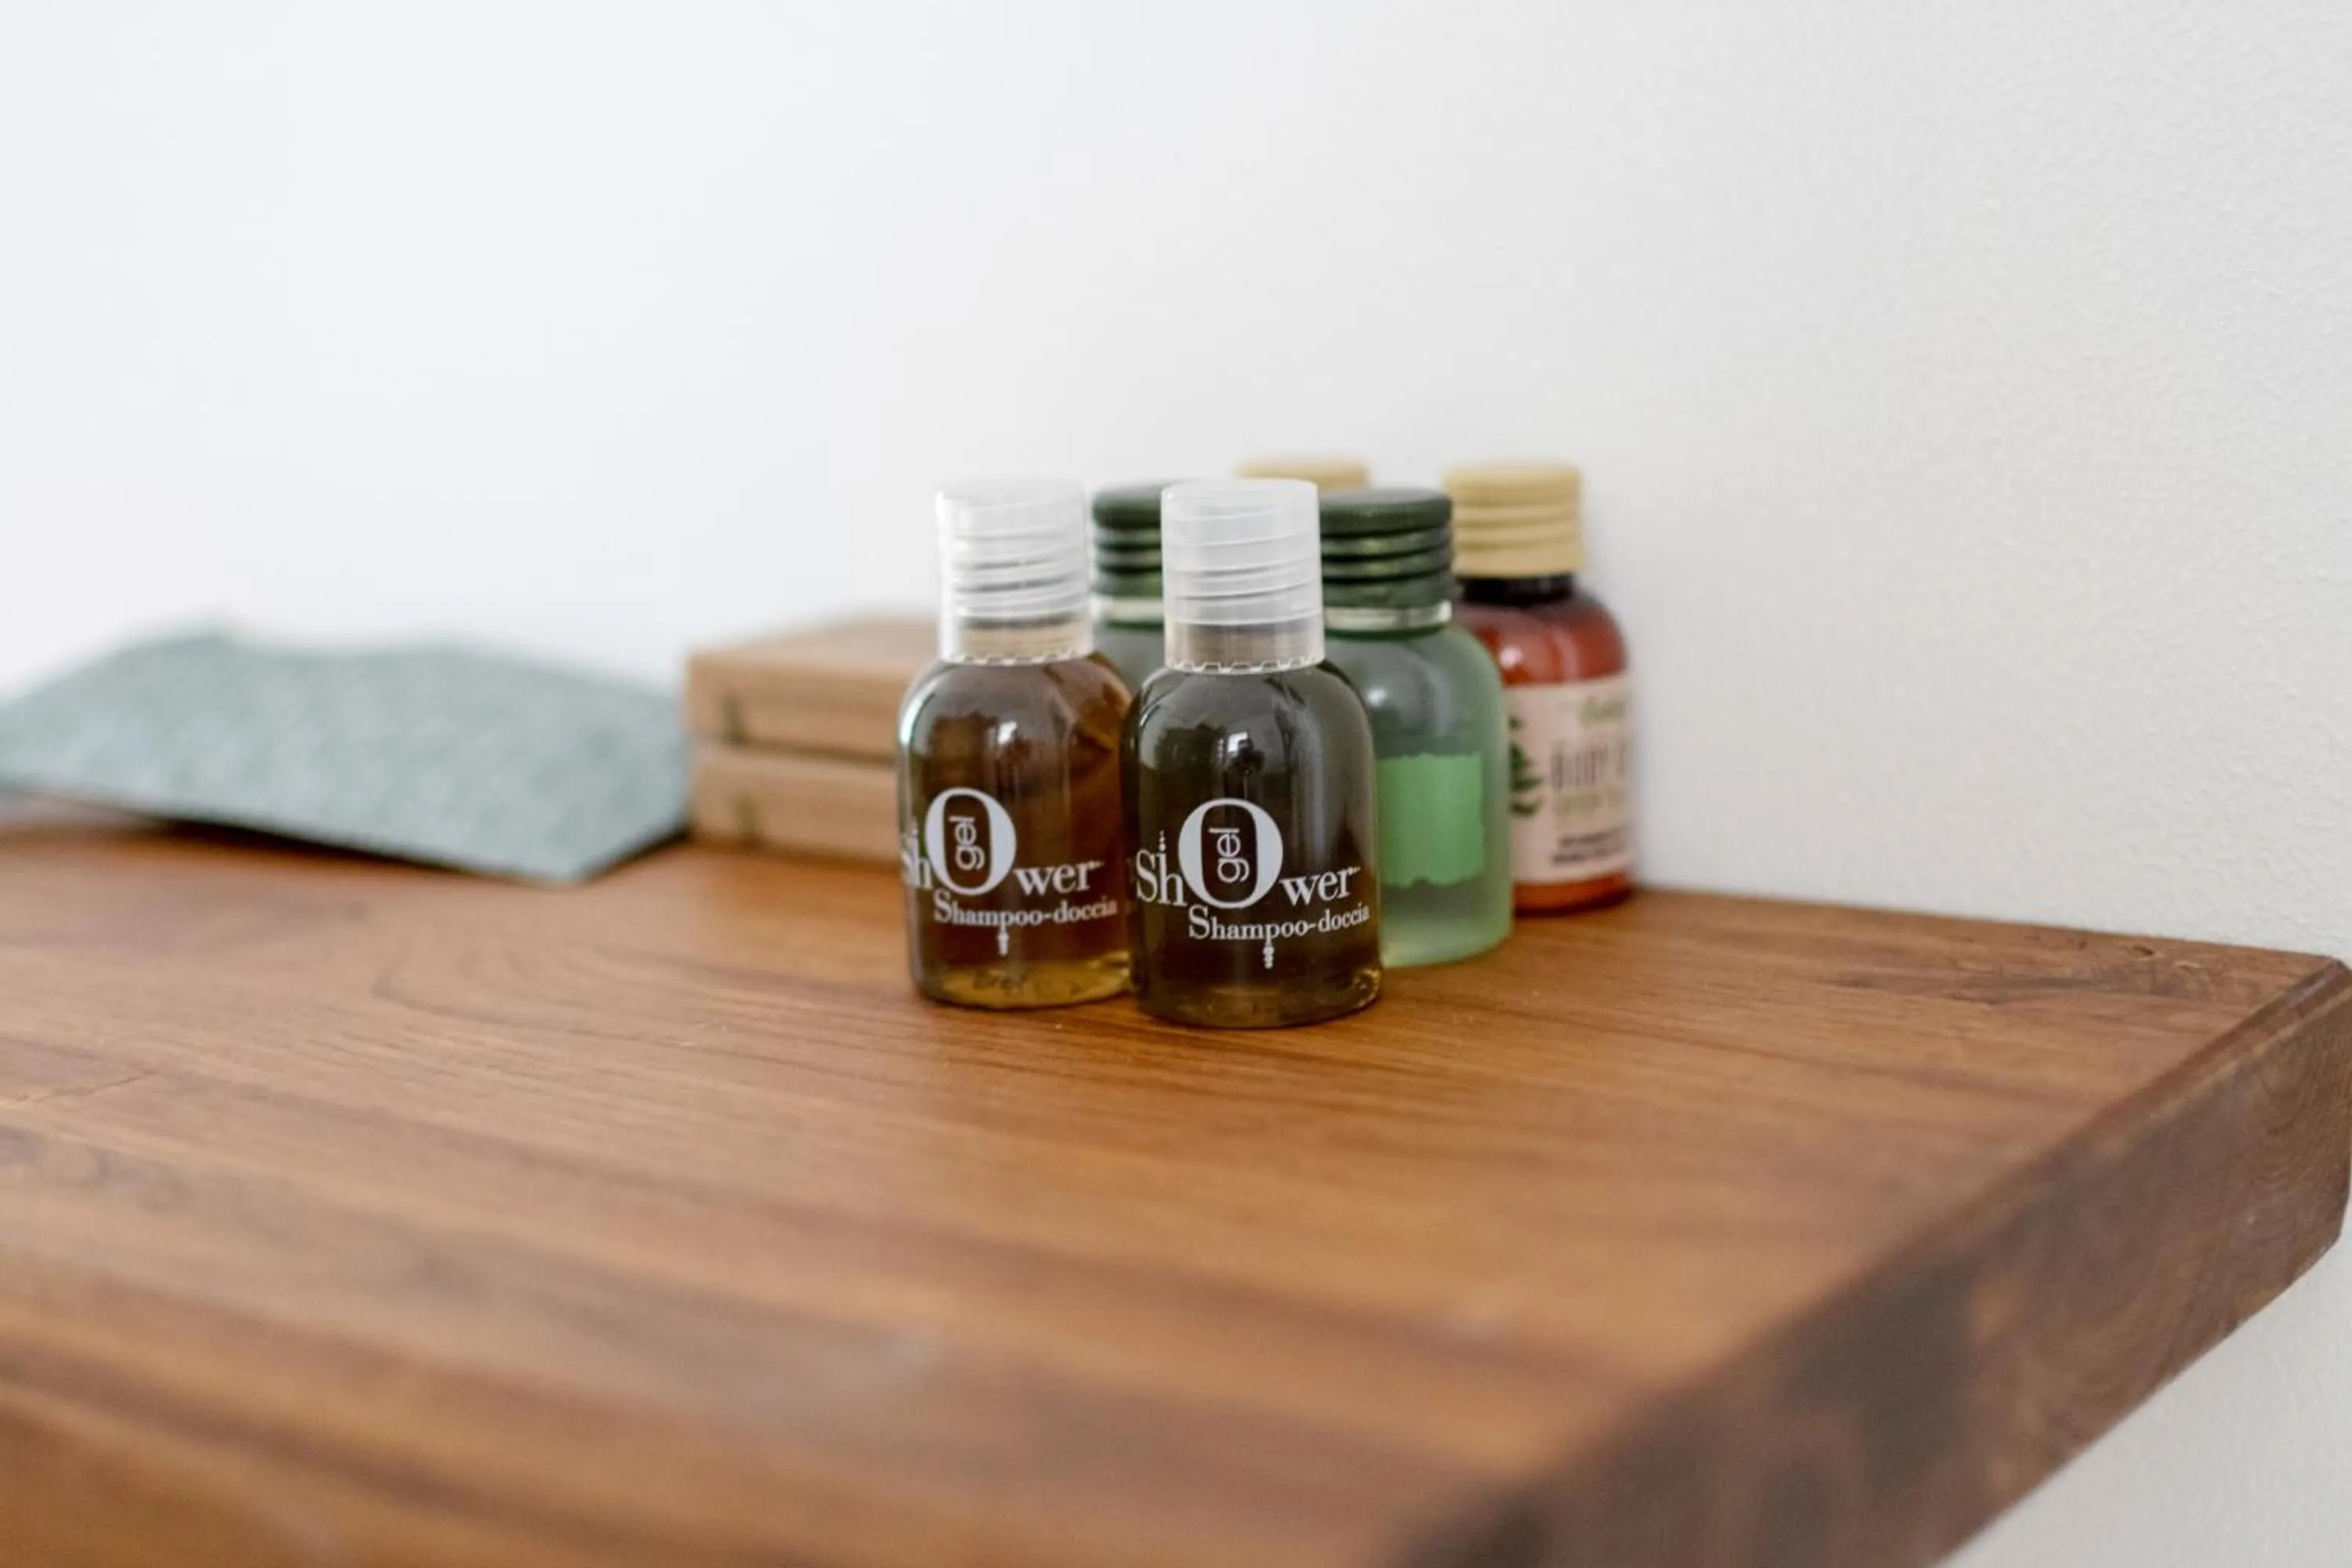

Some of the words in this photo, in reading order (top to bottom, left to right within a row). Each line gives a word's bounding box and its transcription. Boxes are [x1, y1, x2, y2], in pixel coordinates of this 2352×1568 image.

[949, 815, 985, 871] gel
[1207, 826, 1250, 884] gel
[933, 888, 1117, 956] Shampoo-doccia
[1189, 902, 1370, 970] Shampoo-doccia
